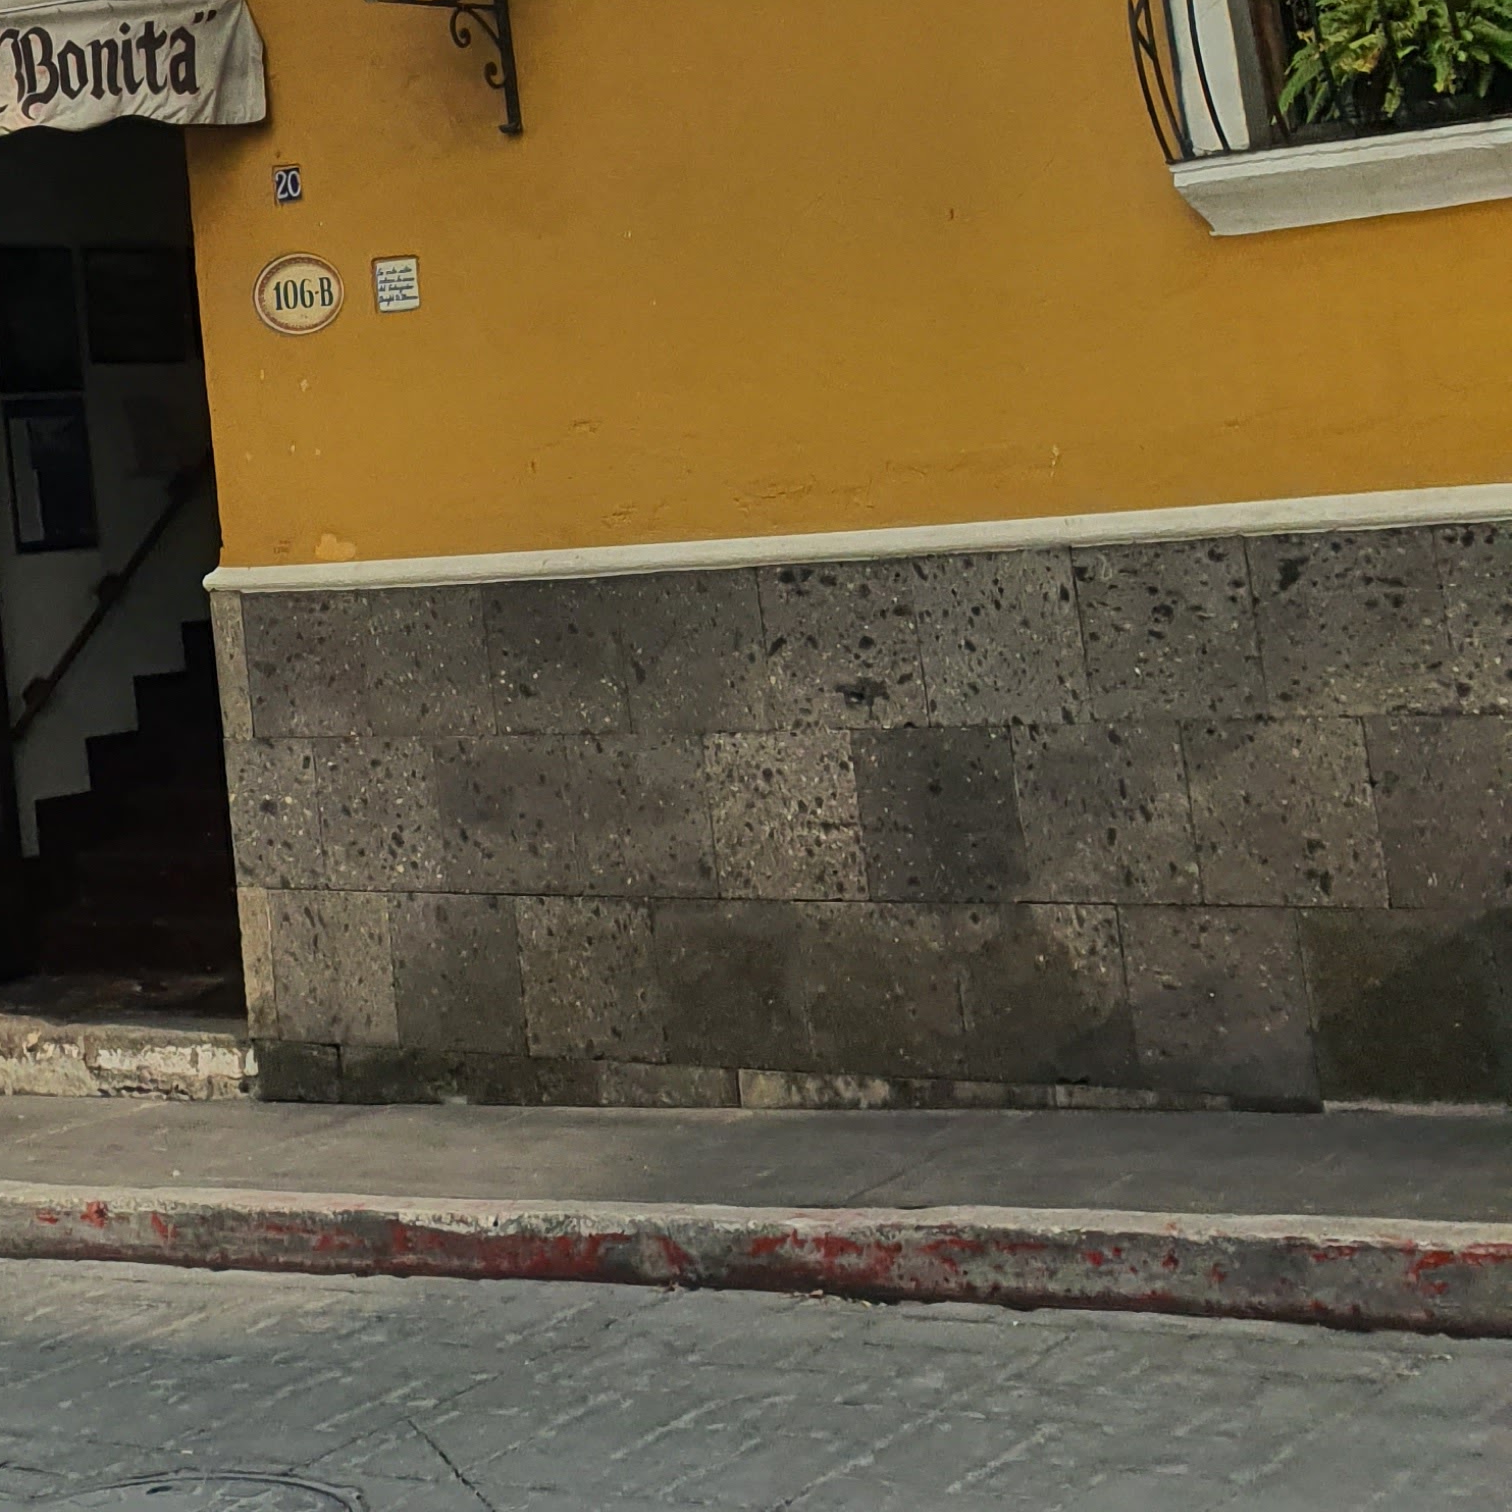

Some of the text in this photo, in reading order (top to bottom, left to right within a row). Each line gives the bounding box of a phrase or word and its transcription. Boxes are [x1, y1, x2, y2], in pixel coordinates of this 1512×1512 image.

[0, 9, 217, 120] Bonita"
[275, 170, 301, 199] 20
[273, 276, 334, 311] 106-B
